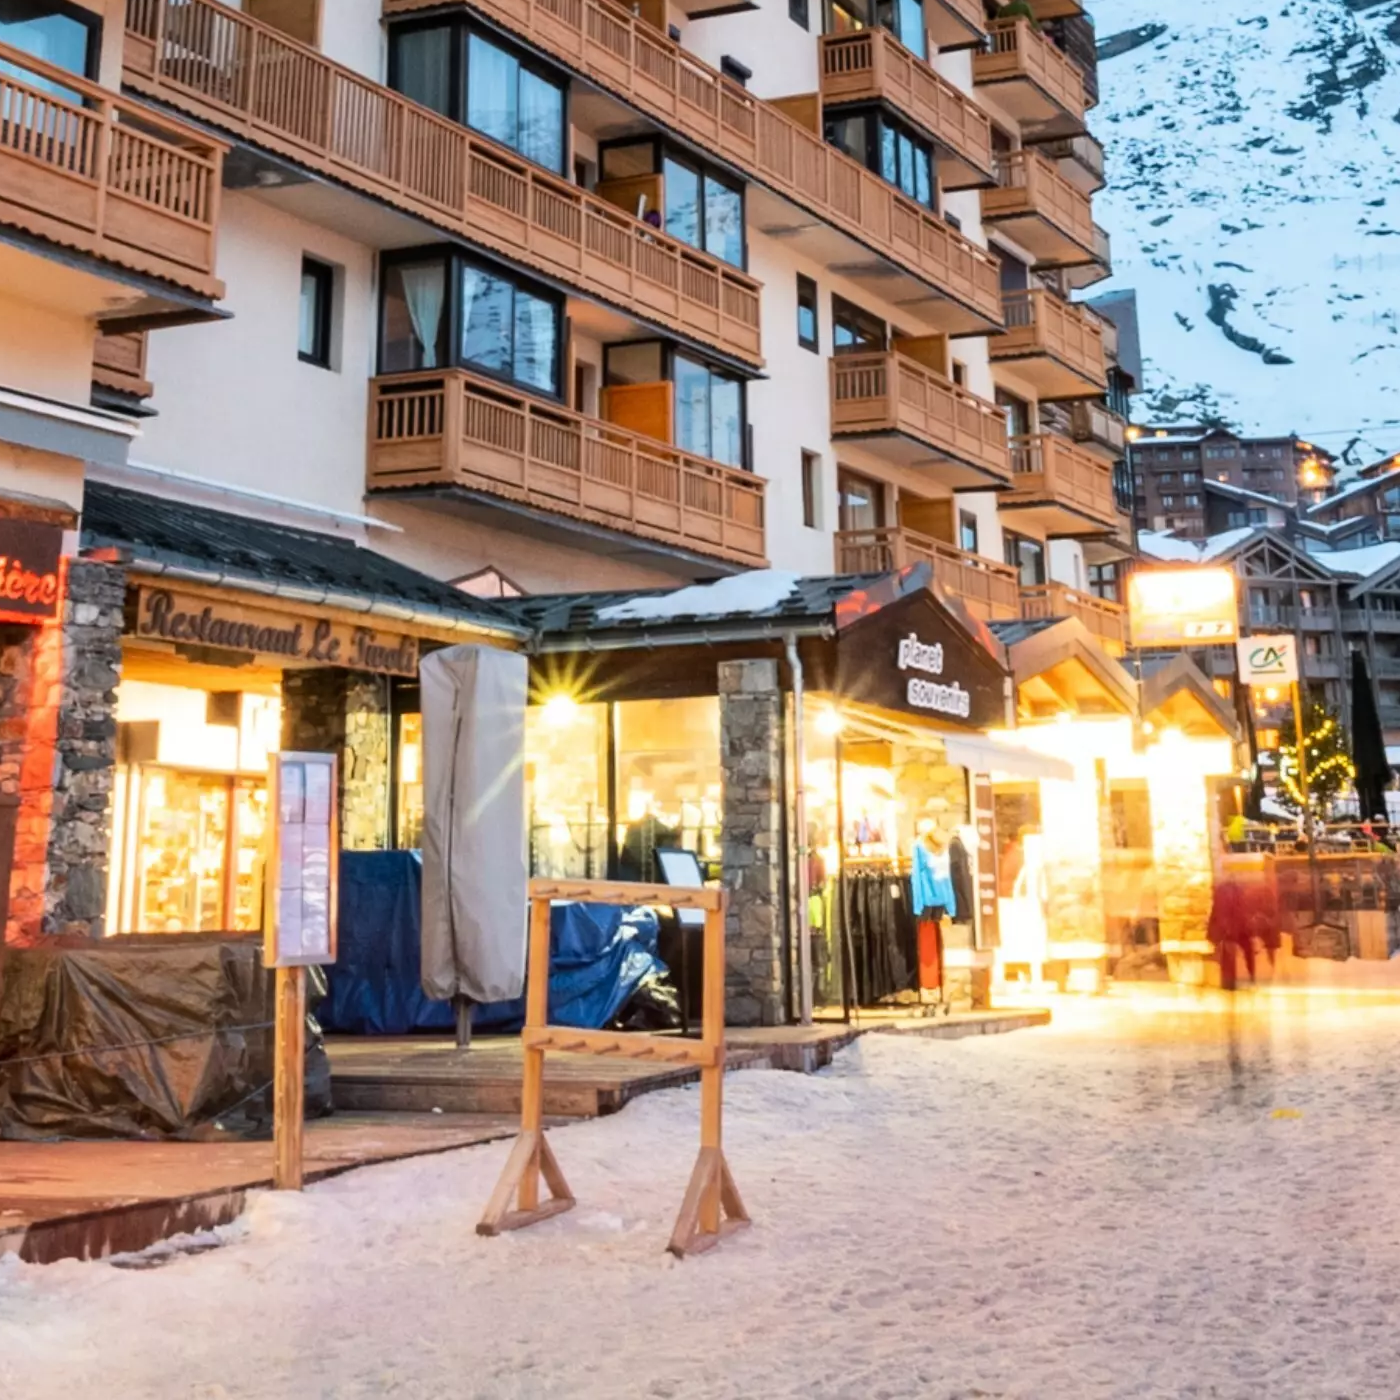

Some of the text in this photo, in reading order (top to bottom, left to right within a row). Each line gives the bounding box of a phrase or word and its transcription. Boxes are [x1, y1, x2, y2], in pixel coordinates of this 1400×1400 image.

[140, 588, 302, 656] Restaurant
[306, 618, 341, 662] Le
[898, 632, 943, 675] planet
[907, 678, 970, 718] souvenirs
